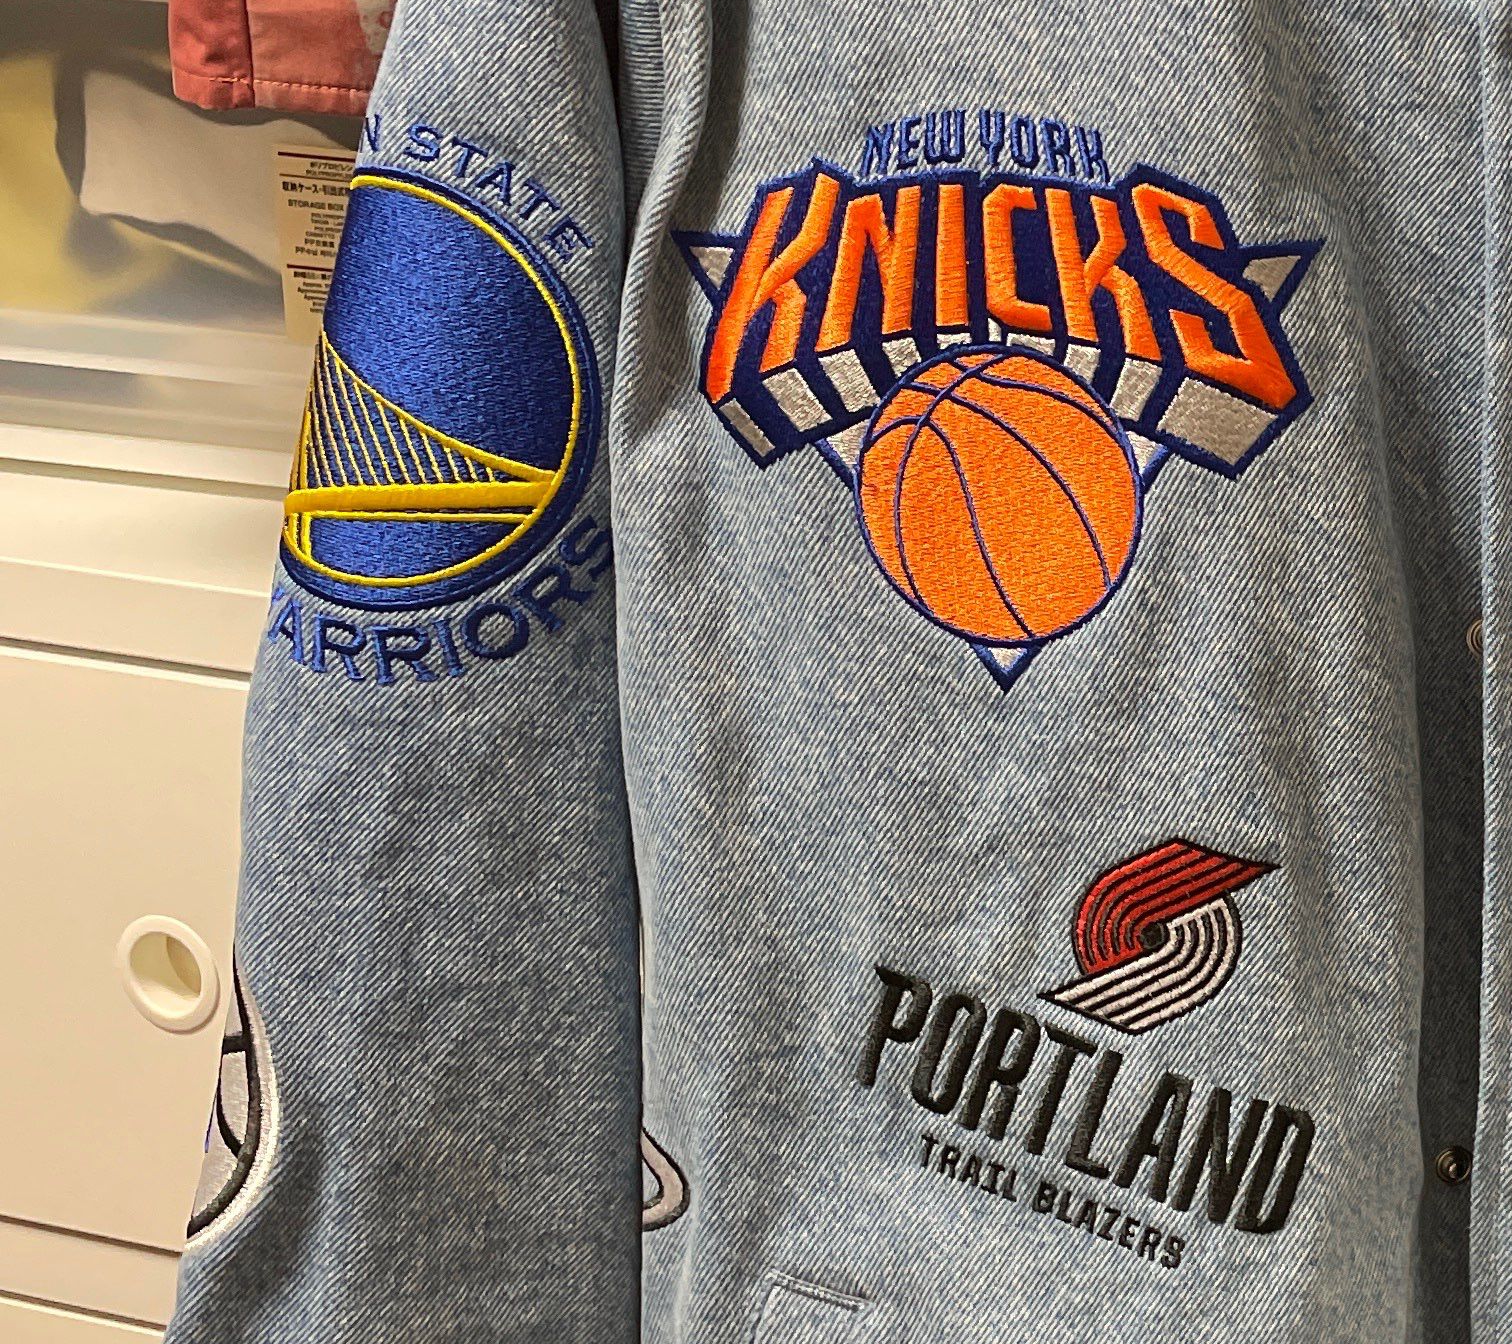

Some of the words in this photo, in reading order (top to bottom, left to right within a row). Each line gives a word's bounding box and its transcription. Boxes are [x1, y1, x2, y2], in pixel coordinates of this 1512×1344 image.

[404, 122, 595, 262] STATE
[861, 108, 968, 176] NEW
[977, 109, 1112, 184] YORK
[702, 168, 1301, 408] KNICKS
[267, 515, 615, 686] ARRIORS
[854, 964, 1316, 1236] PORTLAND
[918, 1133, 1019, 1203] TRAIL
[1032, 1179, 1188, 1270] BLAZERS
